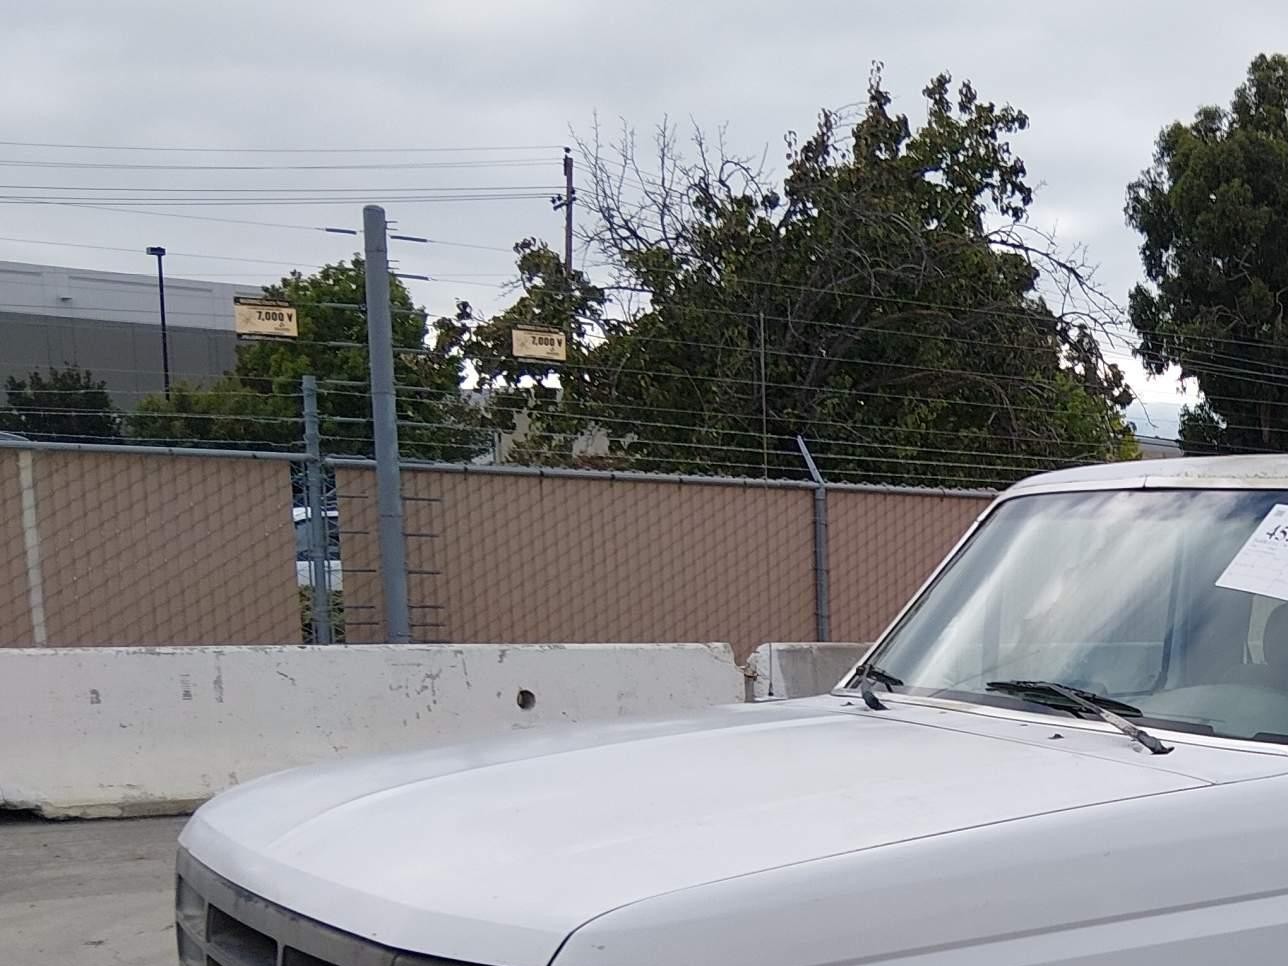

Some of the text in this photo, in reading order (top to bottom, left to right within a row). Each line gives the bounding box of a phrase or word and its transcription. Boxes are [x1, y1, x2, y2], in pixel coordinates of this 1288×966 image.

[256, 310, 293, 322] 7,000 V
[530, 336, 563, 347] 7,000 V
